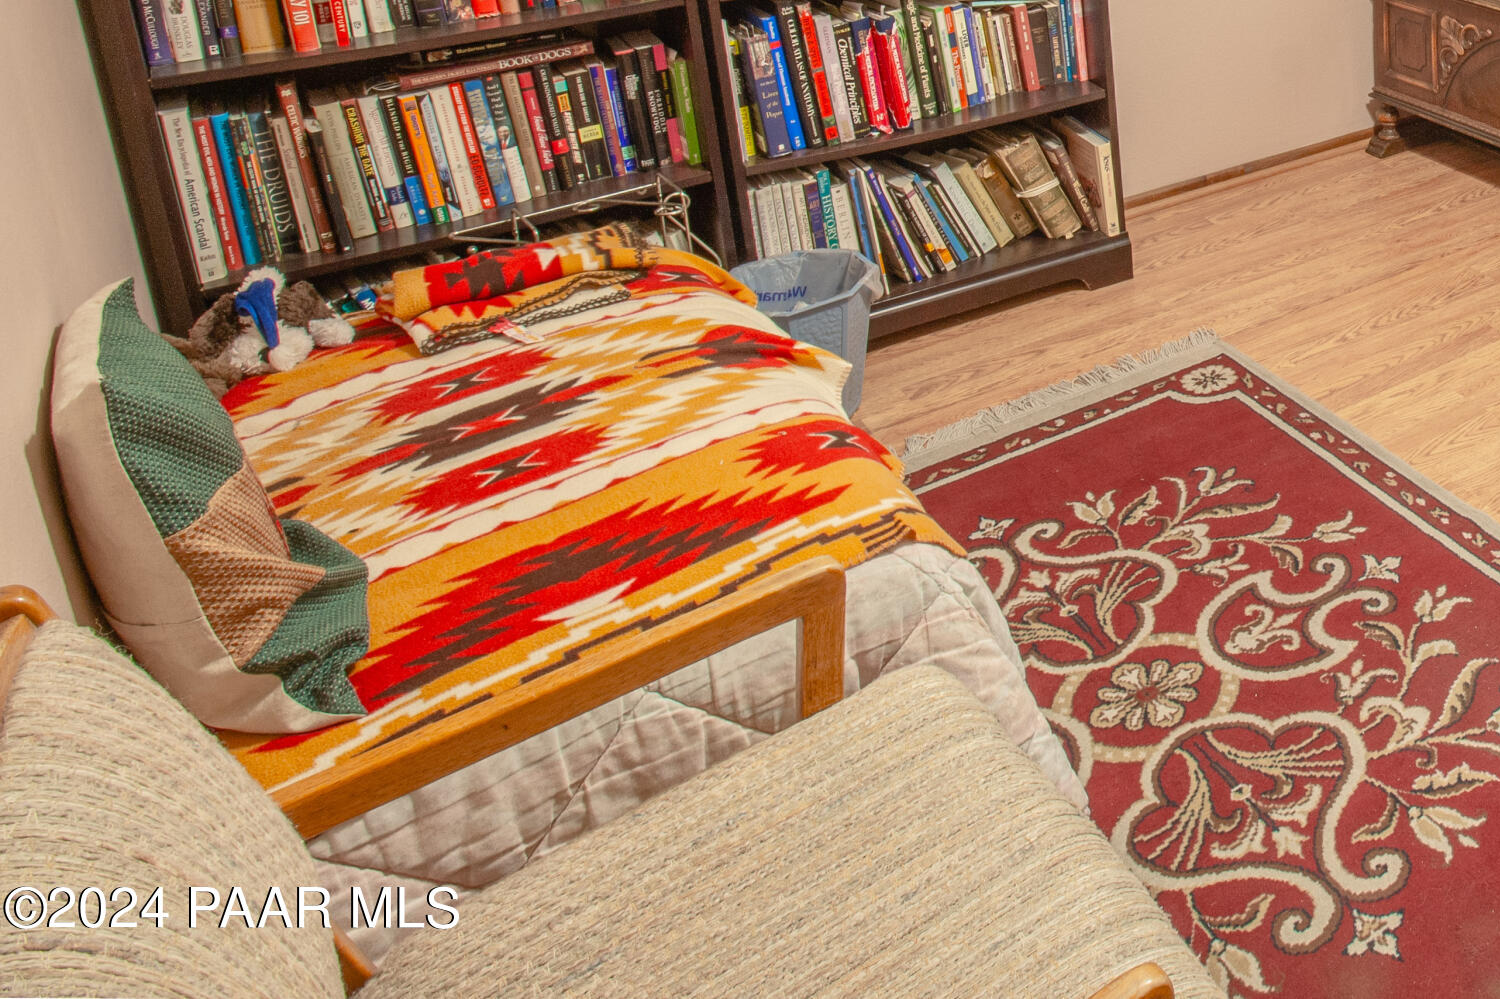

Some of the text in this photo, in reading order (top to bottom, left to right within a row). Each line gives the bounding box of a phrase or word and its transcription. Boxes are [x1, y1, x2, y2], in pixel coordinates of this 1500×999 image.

[293, 10, 310, 26] 101
[334, 1, 345, 33] CENTURY
[911, 17, 919, 31] and
[499, 47, 572, 68] BOOK DOGS
[913, 32, 925, 64] Medicine
[838, 39, 862, 124] Chemical Principles
[921, 75, 932, 98] Plants
[540, 69, 561, 137] OUR ENDANGERED VALUES
[345, 107, 374, 177] CRASHING THE GATE
[254, 130, 295, 233] THE DRUIDS
[184, 178, 211, 250] American Scandal
[822, 194, 837, 240] HISTORY
[836, 197, 852, 239] BERLIN
